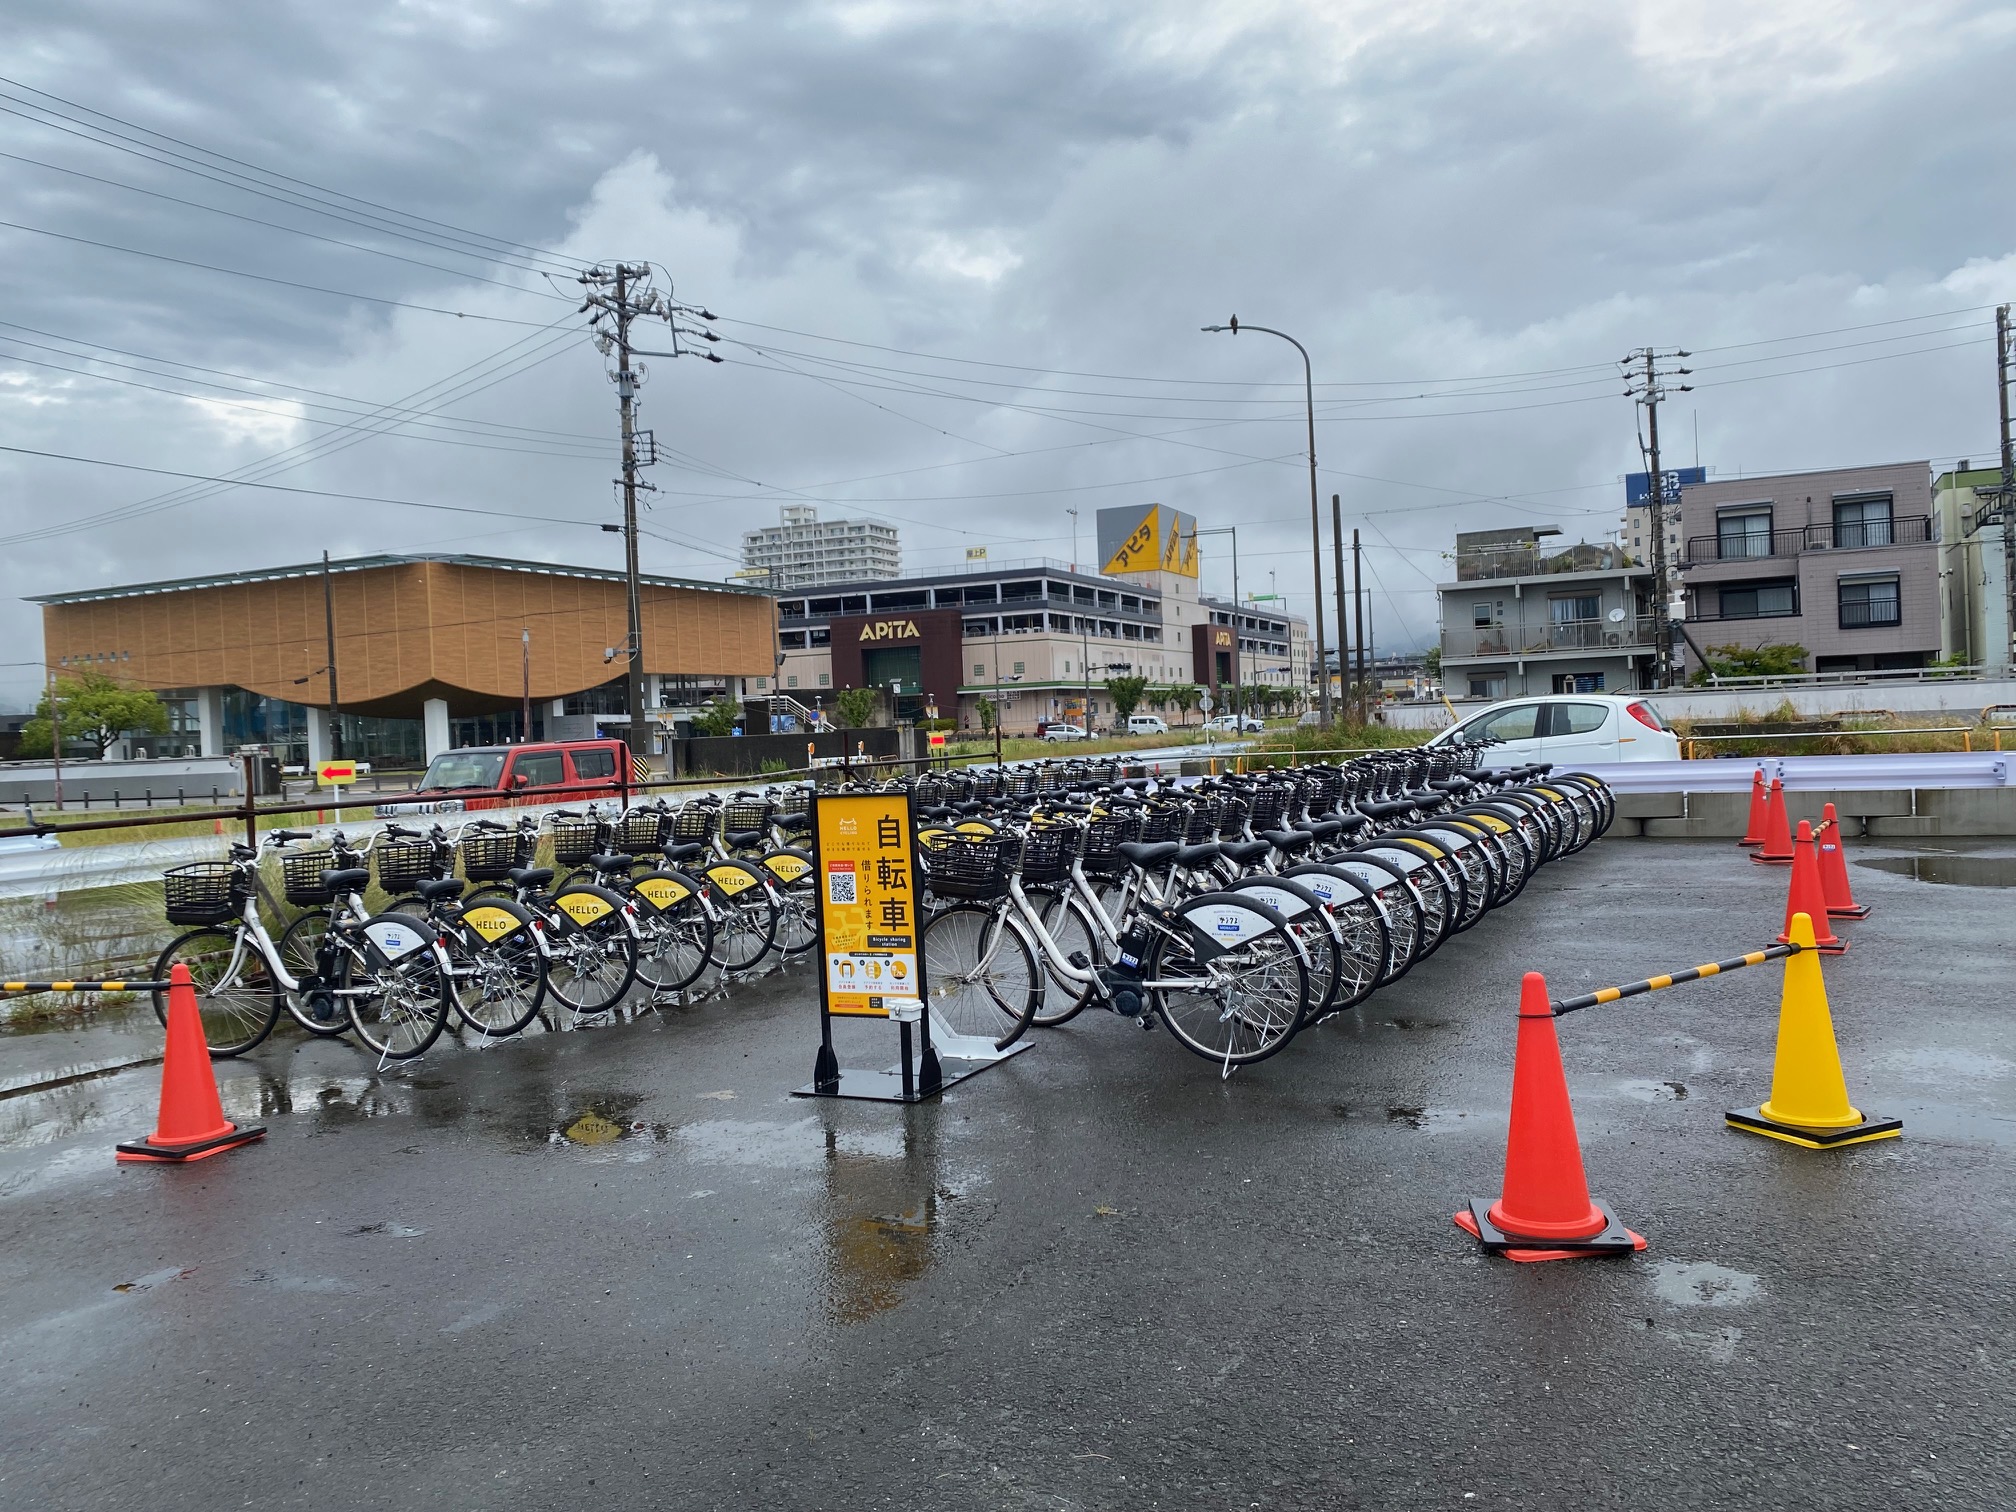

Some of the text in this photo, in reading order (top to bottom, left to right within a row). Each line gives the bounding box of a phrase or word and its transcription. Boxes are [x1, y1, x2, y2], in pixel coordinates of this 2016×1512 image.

[1116, 524, 1150, 567] アピタ
[775, 865, 801, 873] HELLO
[876, 814, 909, 931] 自転車
[717, 877, 745, 886] HELLO
[648, 890, 677, 899] HELLO
[861, 860, 874, 930] 借りられます
[569, 905, 599, 915] HELLO
[476, 920, 506, 930] HELLO
